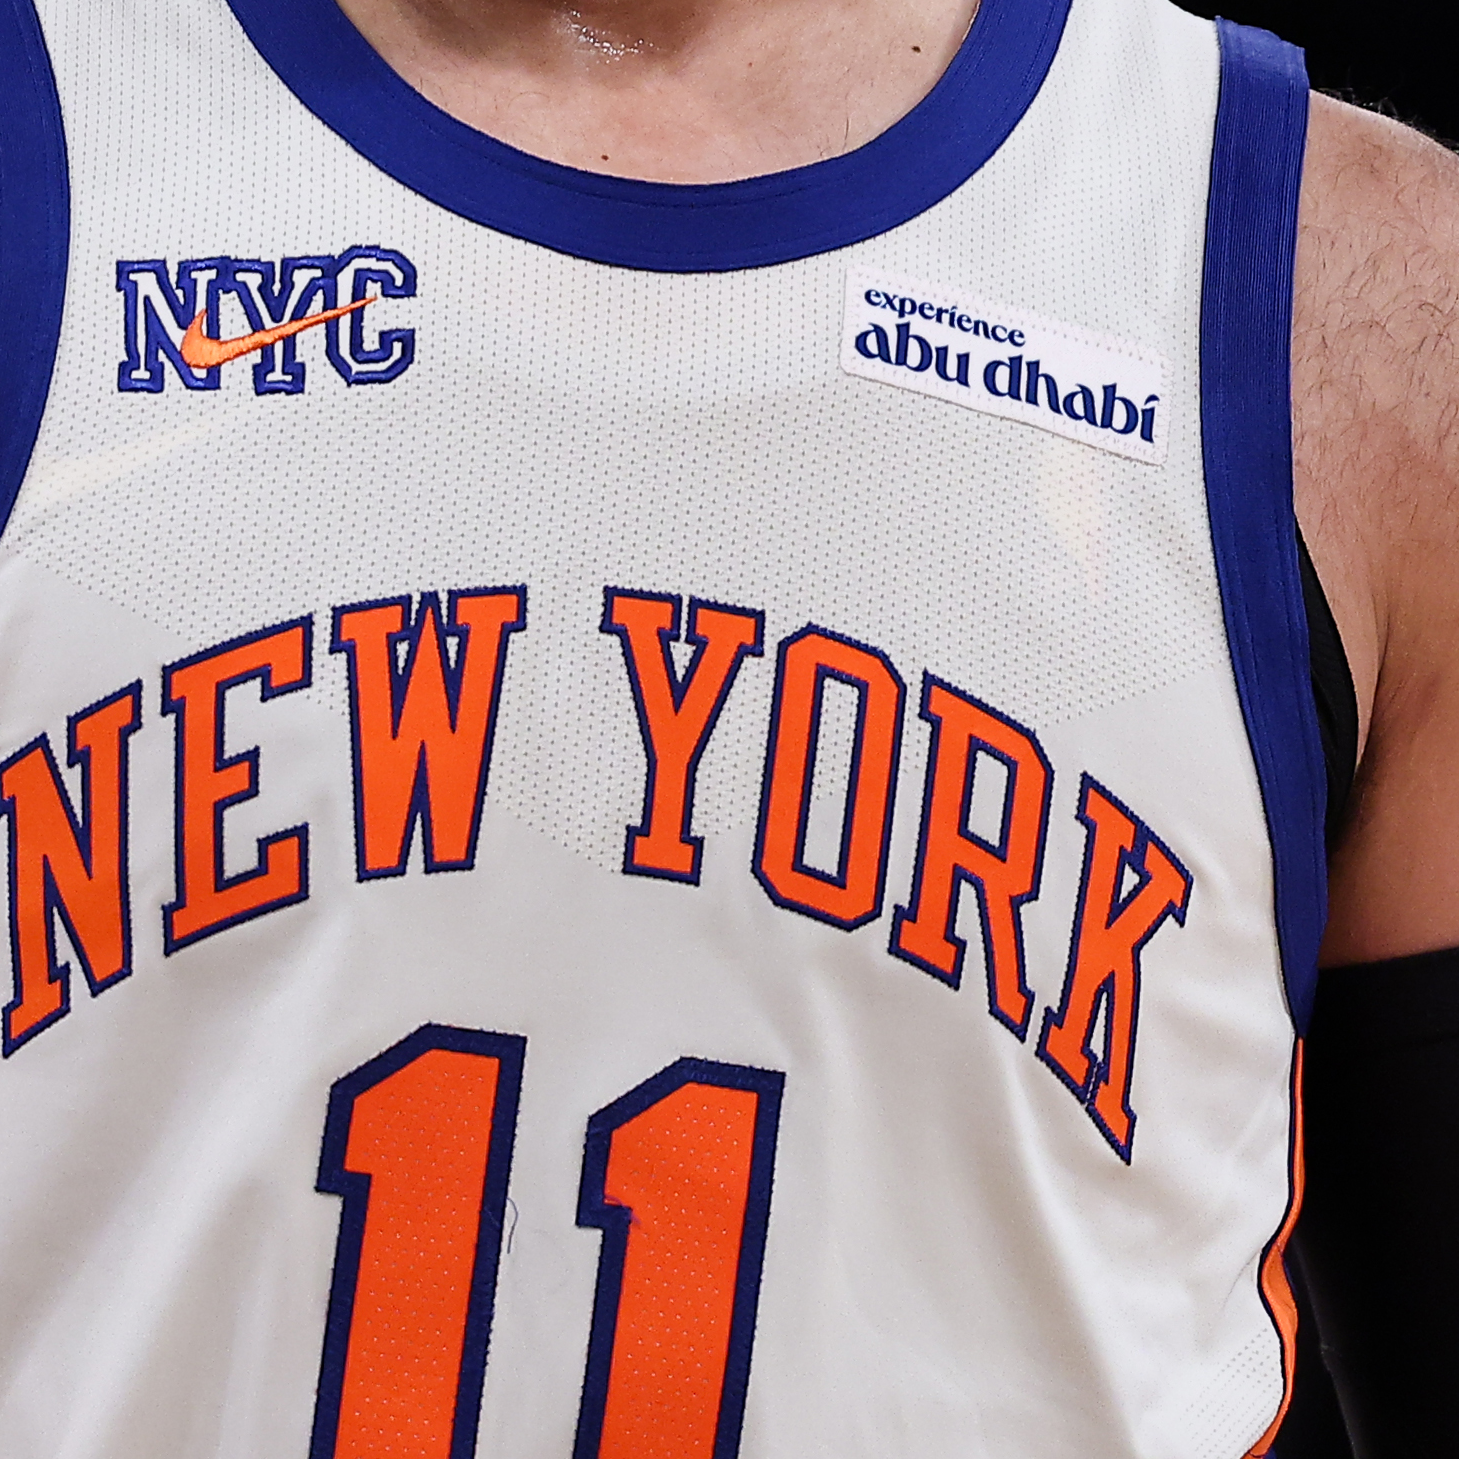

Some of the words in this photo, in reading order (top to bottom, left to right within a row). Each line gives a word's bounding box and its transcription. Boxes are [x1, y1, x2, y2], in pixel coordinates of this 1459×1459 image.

[116, 245, 417, 396] NYC
[855, 321, 970, 388] abu
[983, 355, 1160, 443] dhabi
[864, 288, 1026, 347] experience
[601, 584, 1193, 1165] YORK
[308, 1021, 786, 1459] 11
